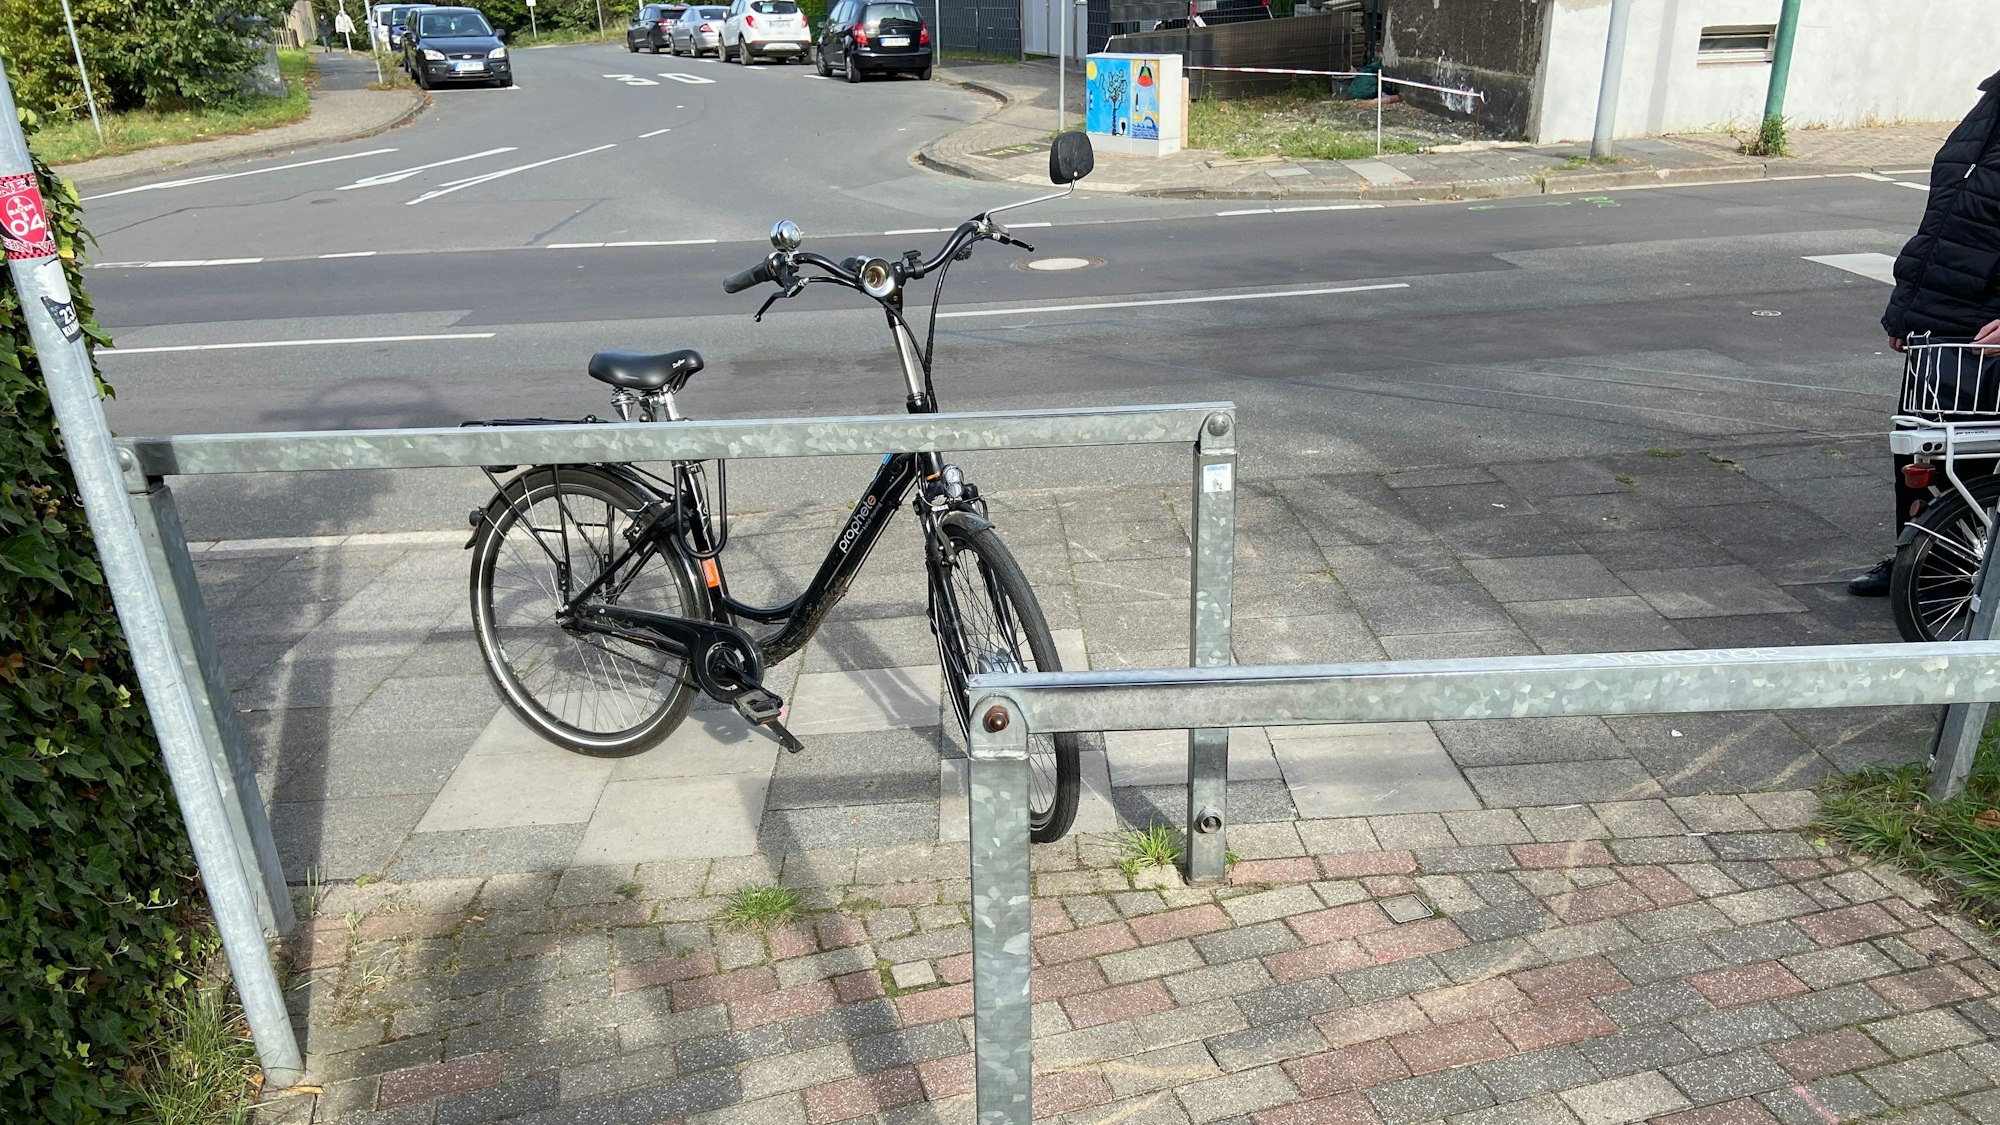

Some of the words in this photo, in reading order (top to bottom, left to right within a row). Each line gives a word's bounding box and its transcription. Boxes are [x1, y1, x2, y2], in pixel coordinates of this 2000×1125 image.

[602, 73, 717, 86] 30
[10, 213, 45, 236] 04
[838, 495, 877, 553] prophete
